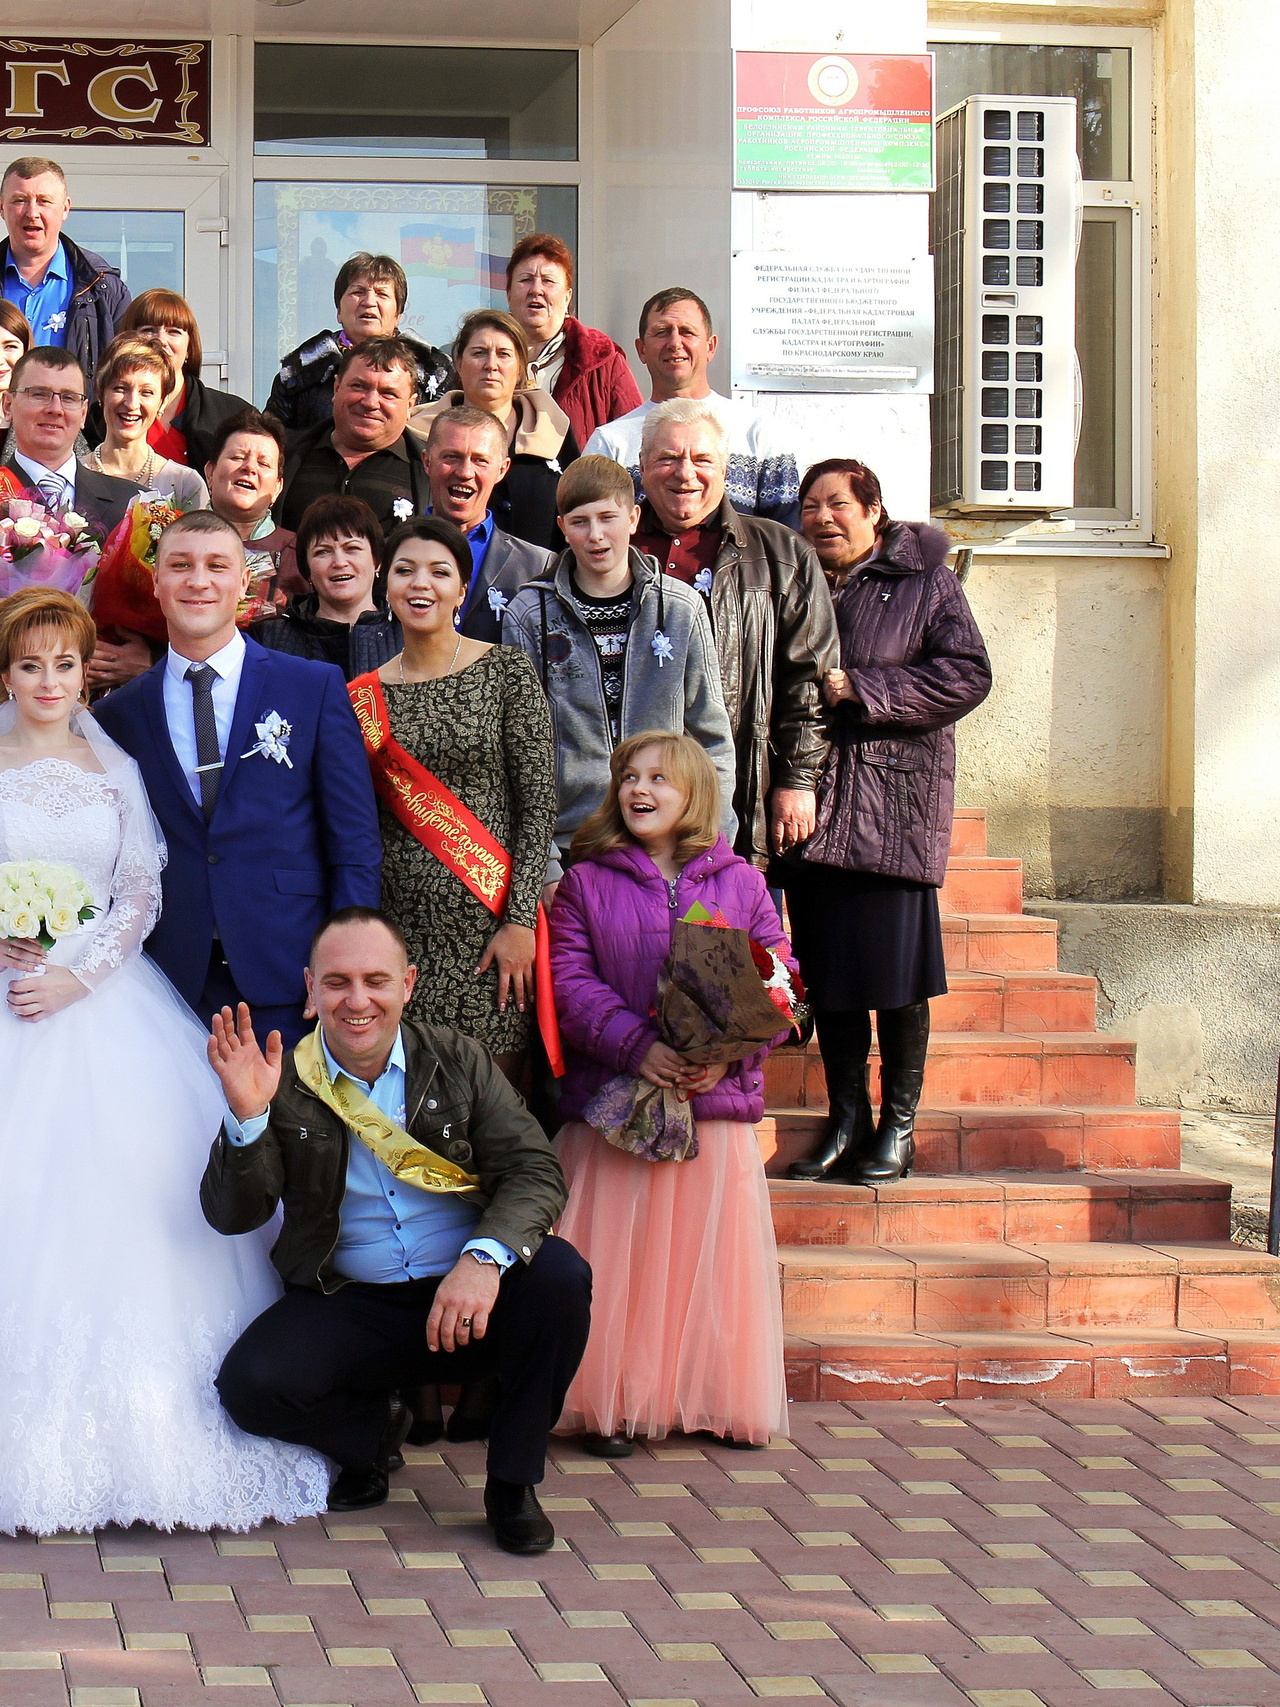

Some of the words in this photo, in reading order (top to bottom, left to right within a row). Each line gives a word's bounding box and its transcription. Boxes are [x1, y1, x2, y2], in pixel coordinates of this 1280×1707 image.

[838, 108, 930, 116] АГРОПРОМЫШЛЕННОГО
[757, 114, 806, 122] КОМПЛЕКСА
[808, 115, 860, 123] РОССИЙСКОЙ
[862, 116, 910, 124] ФЕДЕРАЦИИ
[769, 296, 844, 304] ГОСУДАРСТВЕННОГО
[845, 298, 898, 306] БЮДЖЕТНОГО
[862, 309, 915, 317] КАДАСТРОВАЯ
[821, 318, 876, 326] ФЕДЕРАЛЬНОЙ
[787, 328, 859, 337] ГОСУДАРСТВЕННОЙ
[781, 339, 820, 347] КАДАСТРА
[794, 350, 862, 358] КРАСНОДАРСКОМУ
